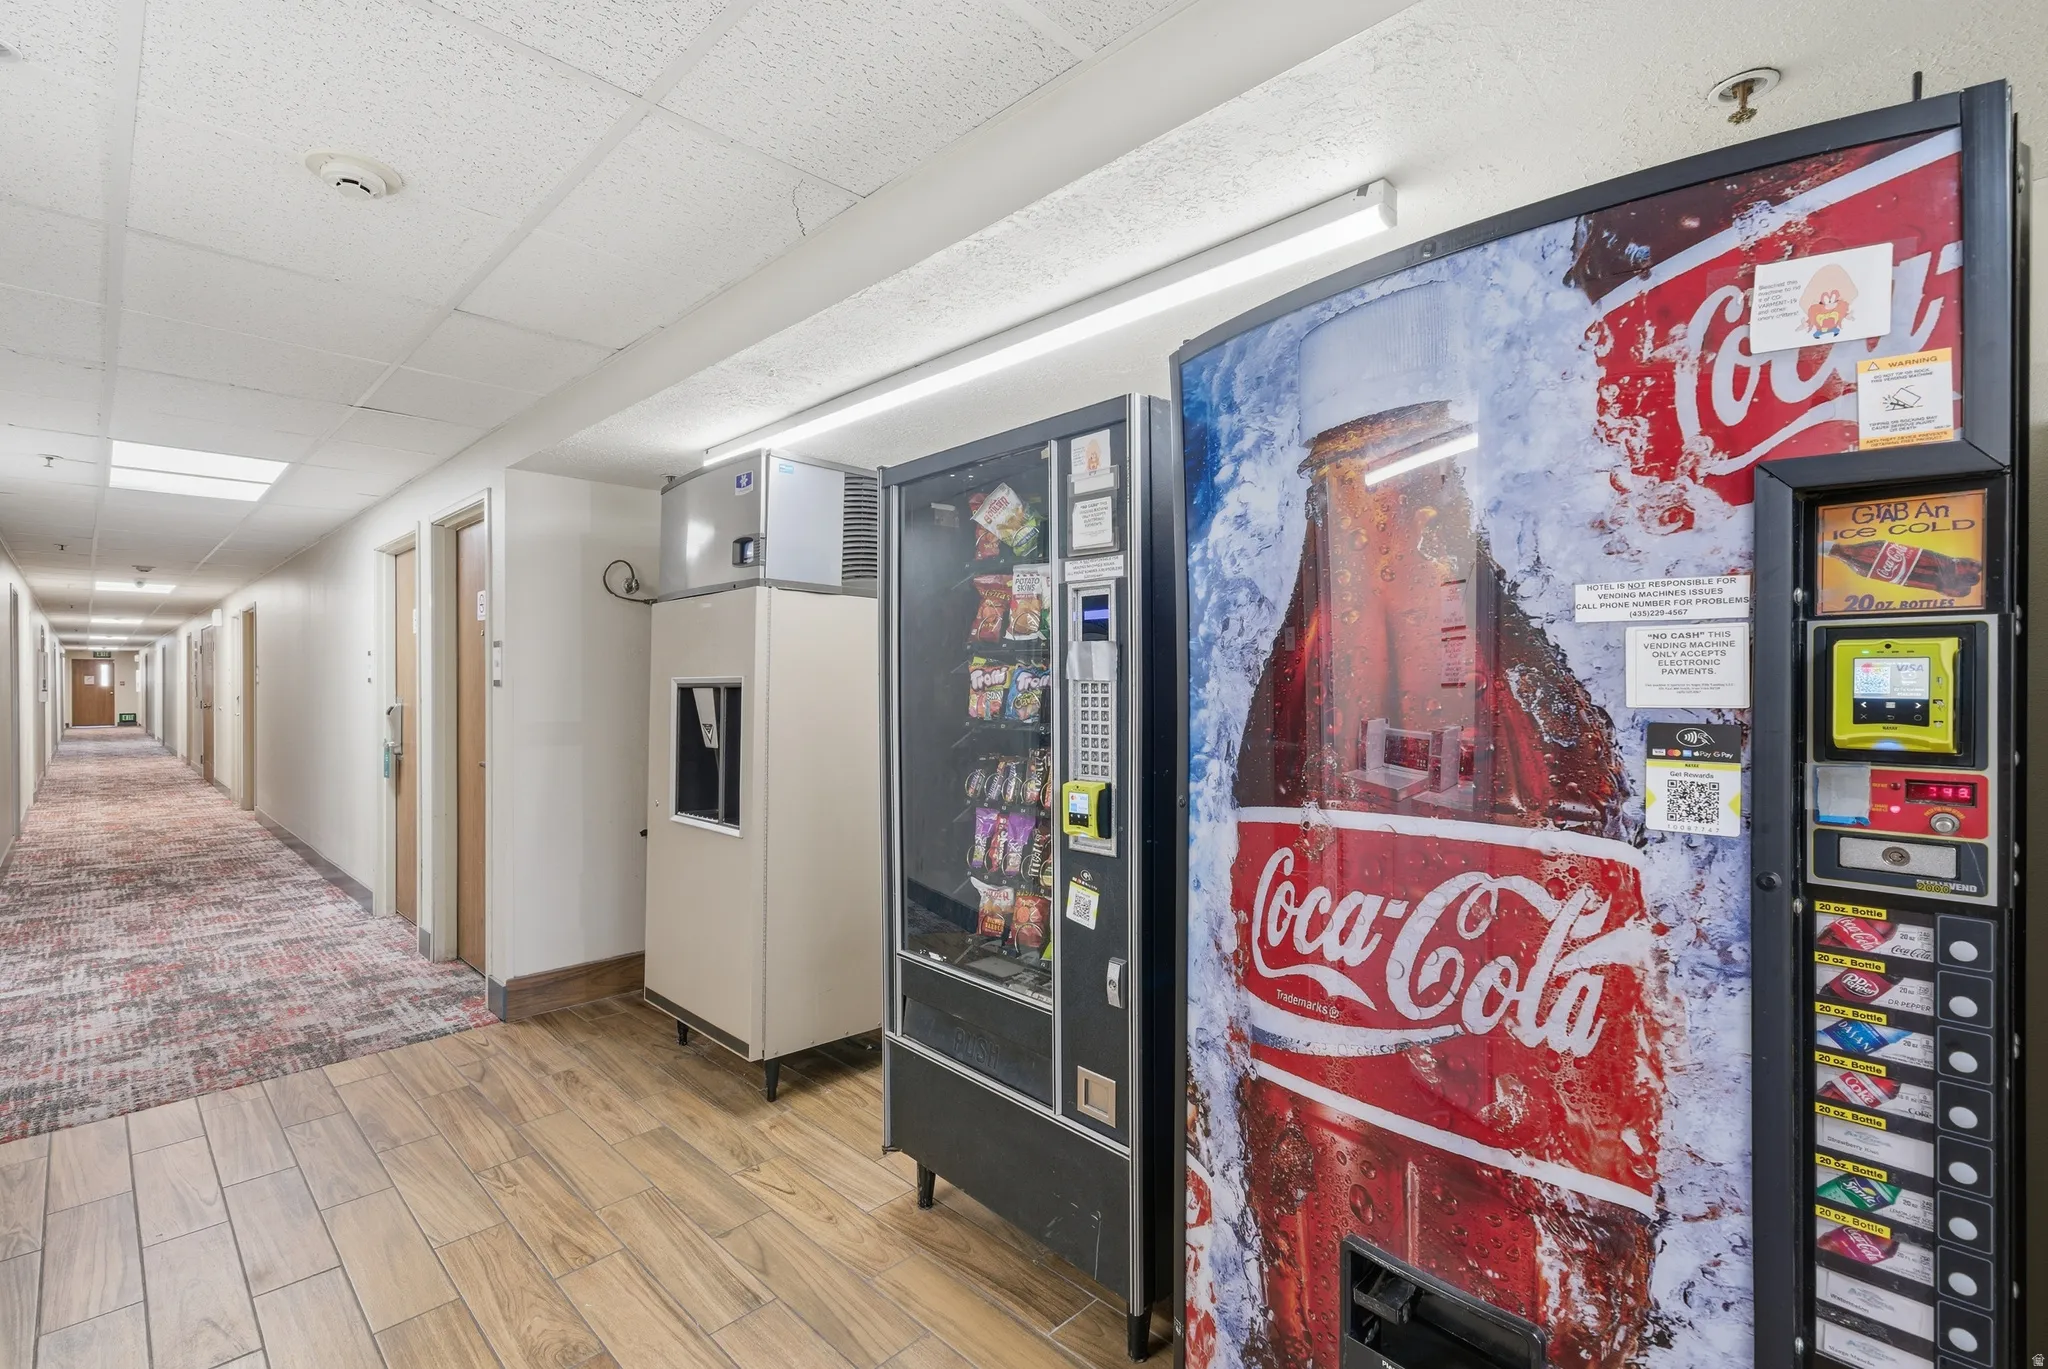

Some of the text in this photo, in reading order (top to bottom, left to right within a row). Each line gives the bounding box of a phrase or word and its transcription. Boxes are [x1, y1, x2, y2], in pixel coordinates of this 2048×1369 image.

[1888, 356, 1938, 368] WARNING
[1914, 502, 1949, 518] An
[1628, 582, 1646, 590] NOT
[1648, 578, 1714, 588] RESPONSIBLE
[1638, 590, 1686, 598] MACHINES
[1688, 588, 1724, 596] ISSUES
[1632, 599, 1671, 608] NUMBER
[1674, 598, 1693, 606] FOR
[1696, 596, 1750, 605] PROBLEMS
[1844, 594, 1874, 611] 20
[1900, 598, 1956, 610] BOTTLES
[1630, 609, 1688, 618] (435)229-4567
[1644, 640, 1736, 650] VENDING MACHINE
[1658, 658, 1720, 666] ELECTRONIC
[970, 667, 1008, 691] Trolli
[1852, 907, 1883, 918] Bottle
[1251, 846, 1612, 1058] Coca-Cola
[1850, 959, 1882, 971] Bottle
[1901, 1000, 1932, 1012] PEPPER
[1852, 1010, 1883, 1023] Bottle
[1838, 1020, 1874, 1052] DASANI
[953, 1026, 1000, 1070] PUSH
[1851, 1061, 1882, 1074] Bottle
[1845, 1076, 1874, 1104] Coke
[1834, 1110, 1848, 1118] oz.
[1852, 1113, 1882, 1127] Bottle
[1820, 1156, 1883, 1179] 20 oz. Bottle
[1842, 1180, 1876, 1205] Sprite
[1819, 1207, 1885, 1235] 20 oz. Bottle
